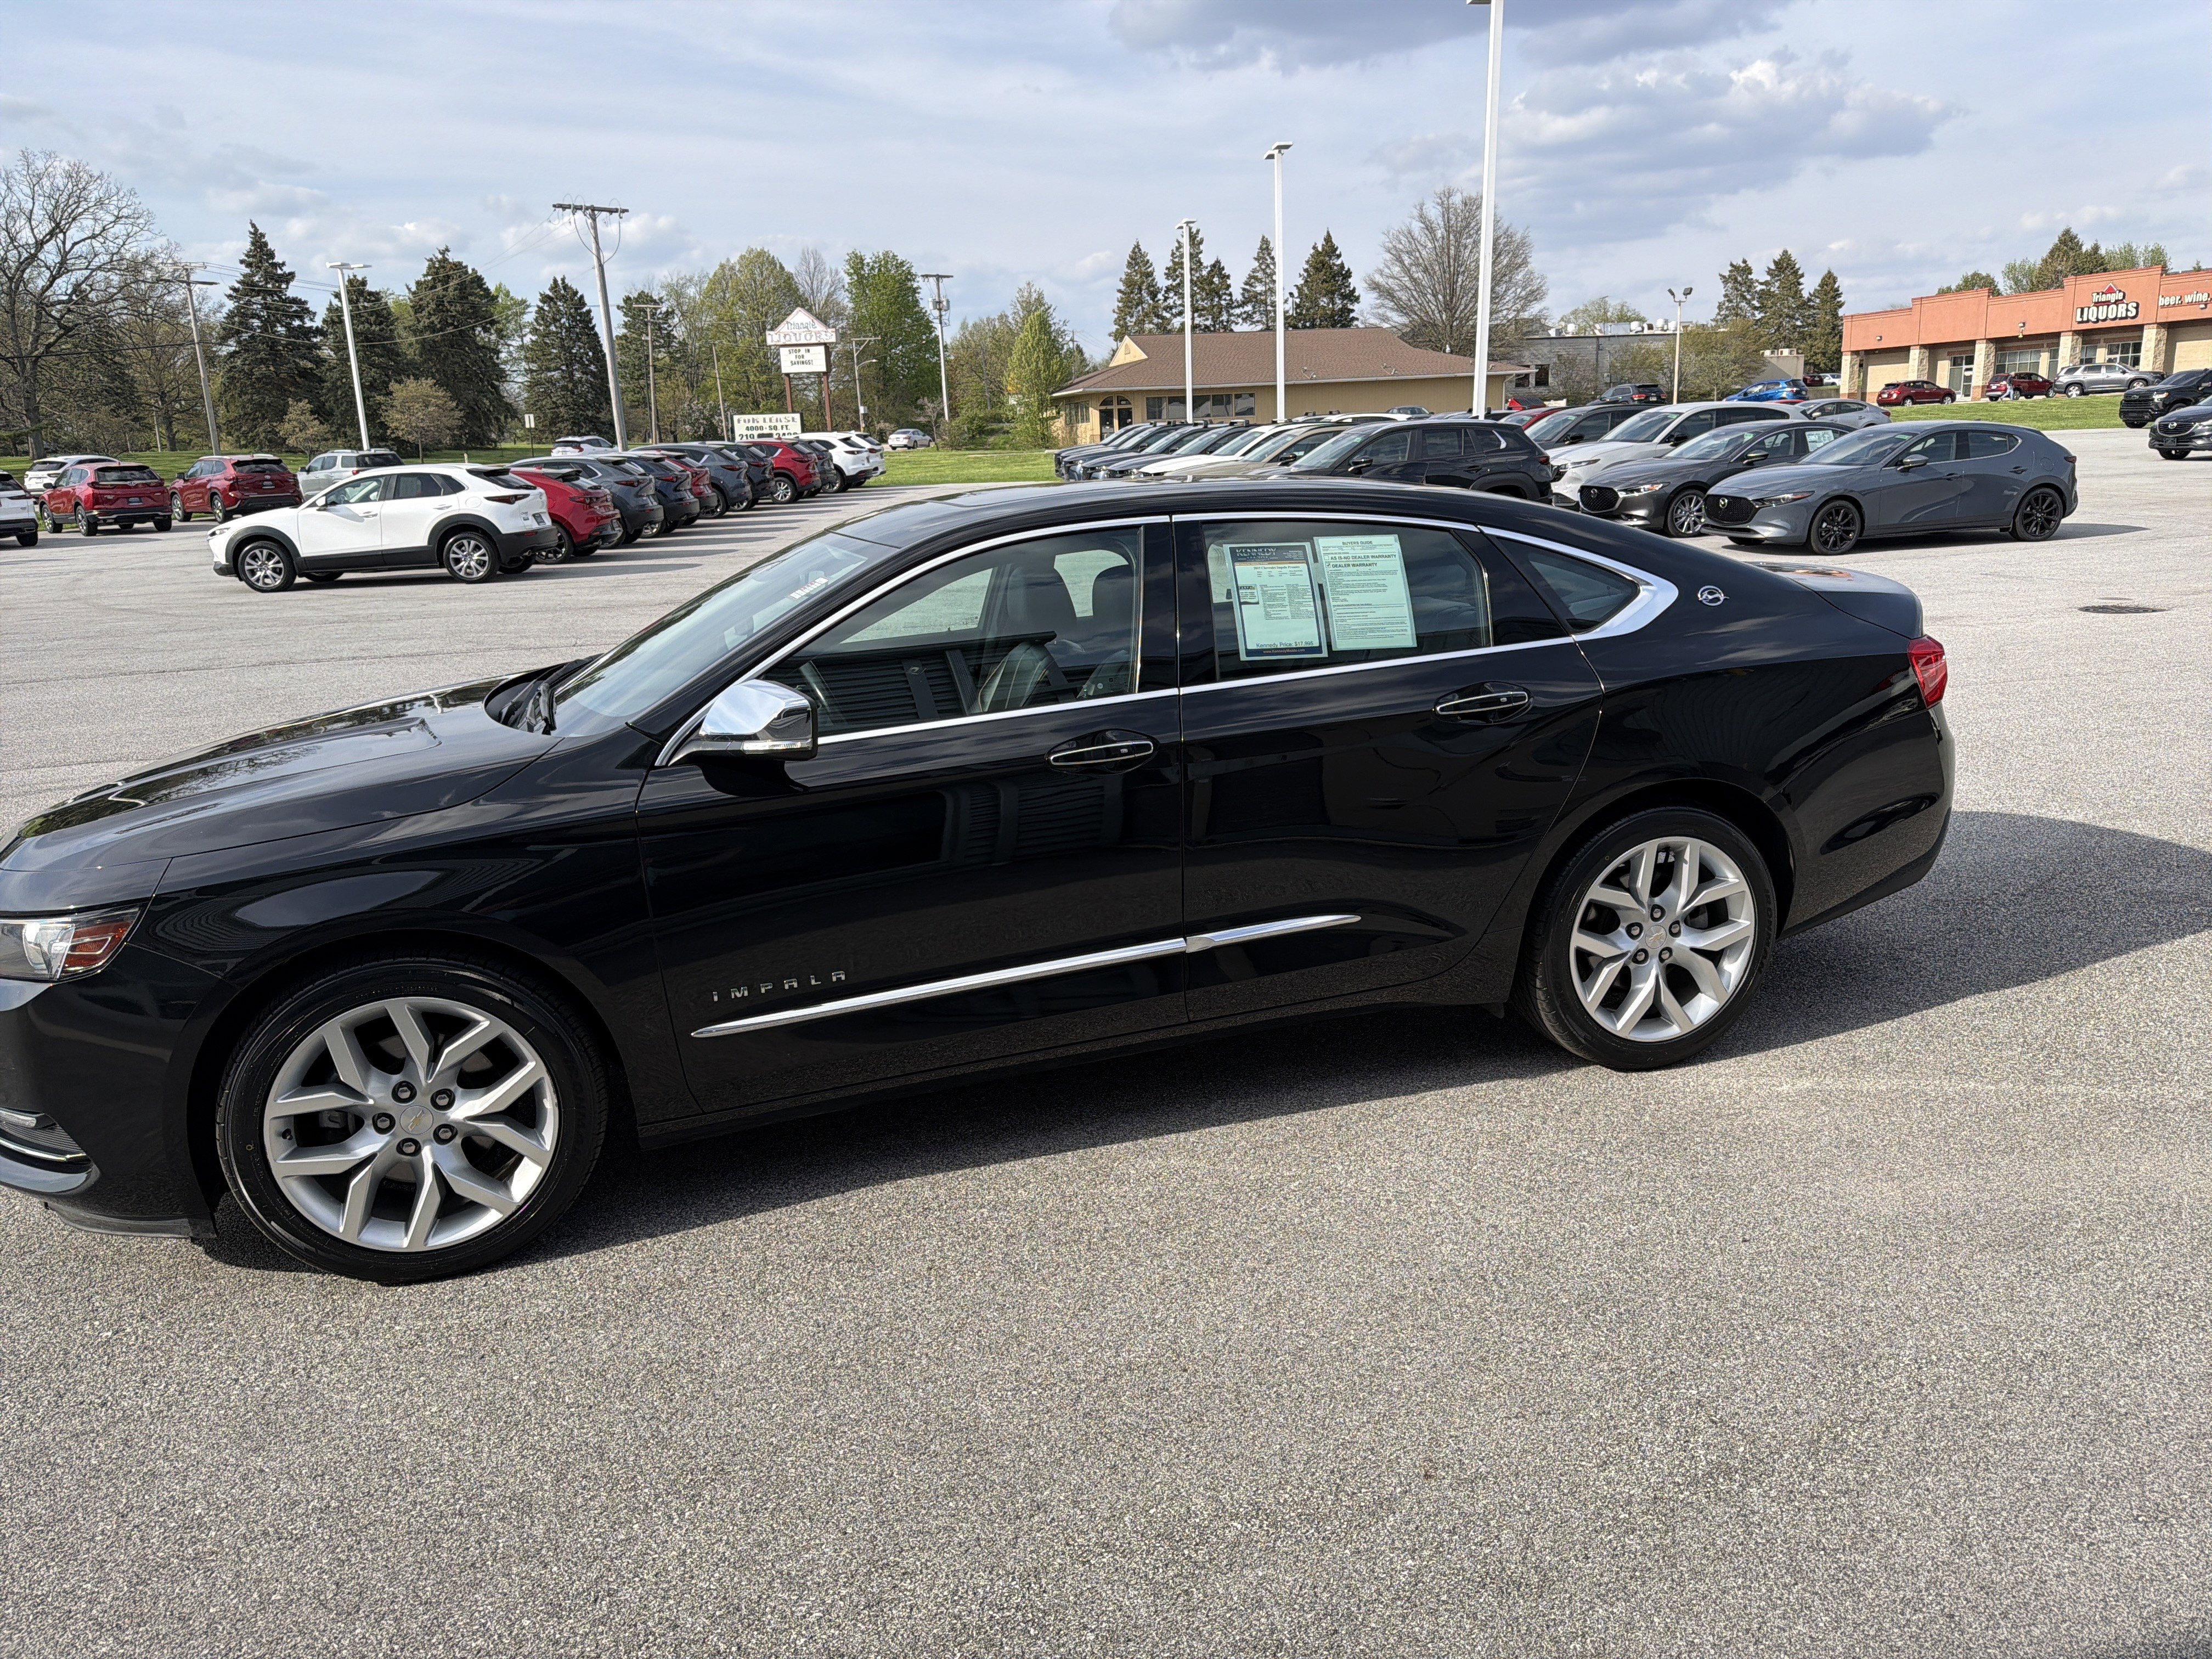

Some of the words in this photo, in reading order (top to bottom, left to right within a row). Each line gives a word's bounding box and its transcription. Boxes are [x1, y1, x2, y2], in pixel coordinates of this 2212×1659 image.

[2092, 291, 2124, 302] Triangle
[2159, 294, 2181, 306] beer.
[2185, 291, 2210, 303] wine.
[2076, 302, 2138, 322] LIQUORS
[1236, 548, 1277, 556] KENNEDY
[712, 970, 845, 1002] IMPALA
